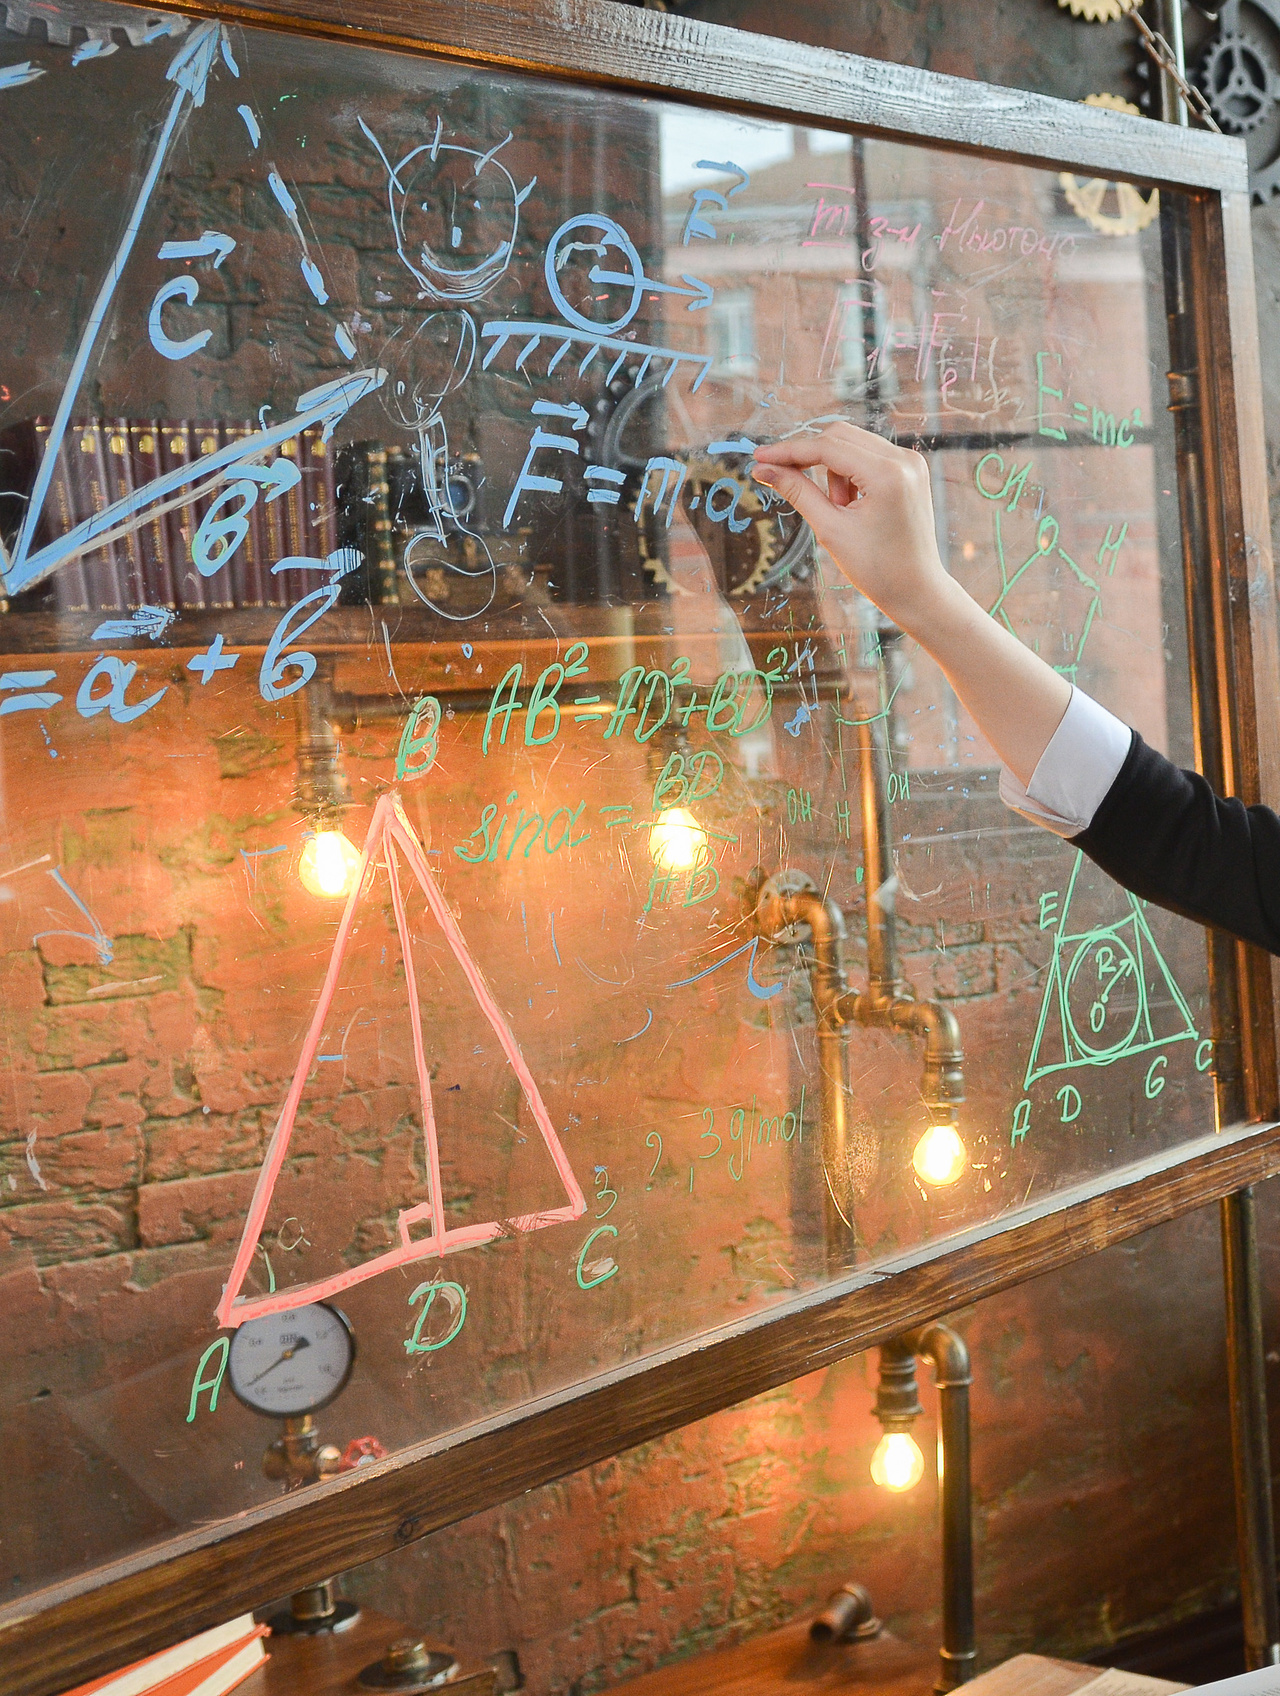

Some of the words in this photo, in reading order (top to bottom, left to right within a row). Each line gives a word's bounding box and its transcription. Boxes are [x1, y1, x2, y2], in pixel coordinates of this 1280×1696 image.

[397, 695, 441, 780] B
[1039, 891, 1058, 930] E
[1096, 946, 1117, 980] R
[1195, 1039, 1213, 1072] C
[1011, 1099, 1031, 1148] A
[1057, 1085, 1082, 1122] D
[576, 1225, 619, 1290] C
[403, 1281, 467, 1353] D
[186, 1336, 230, 1423] A
